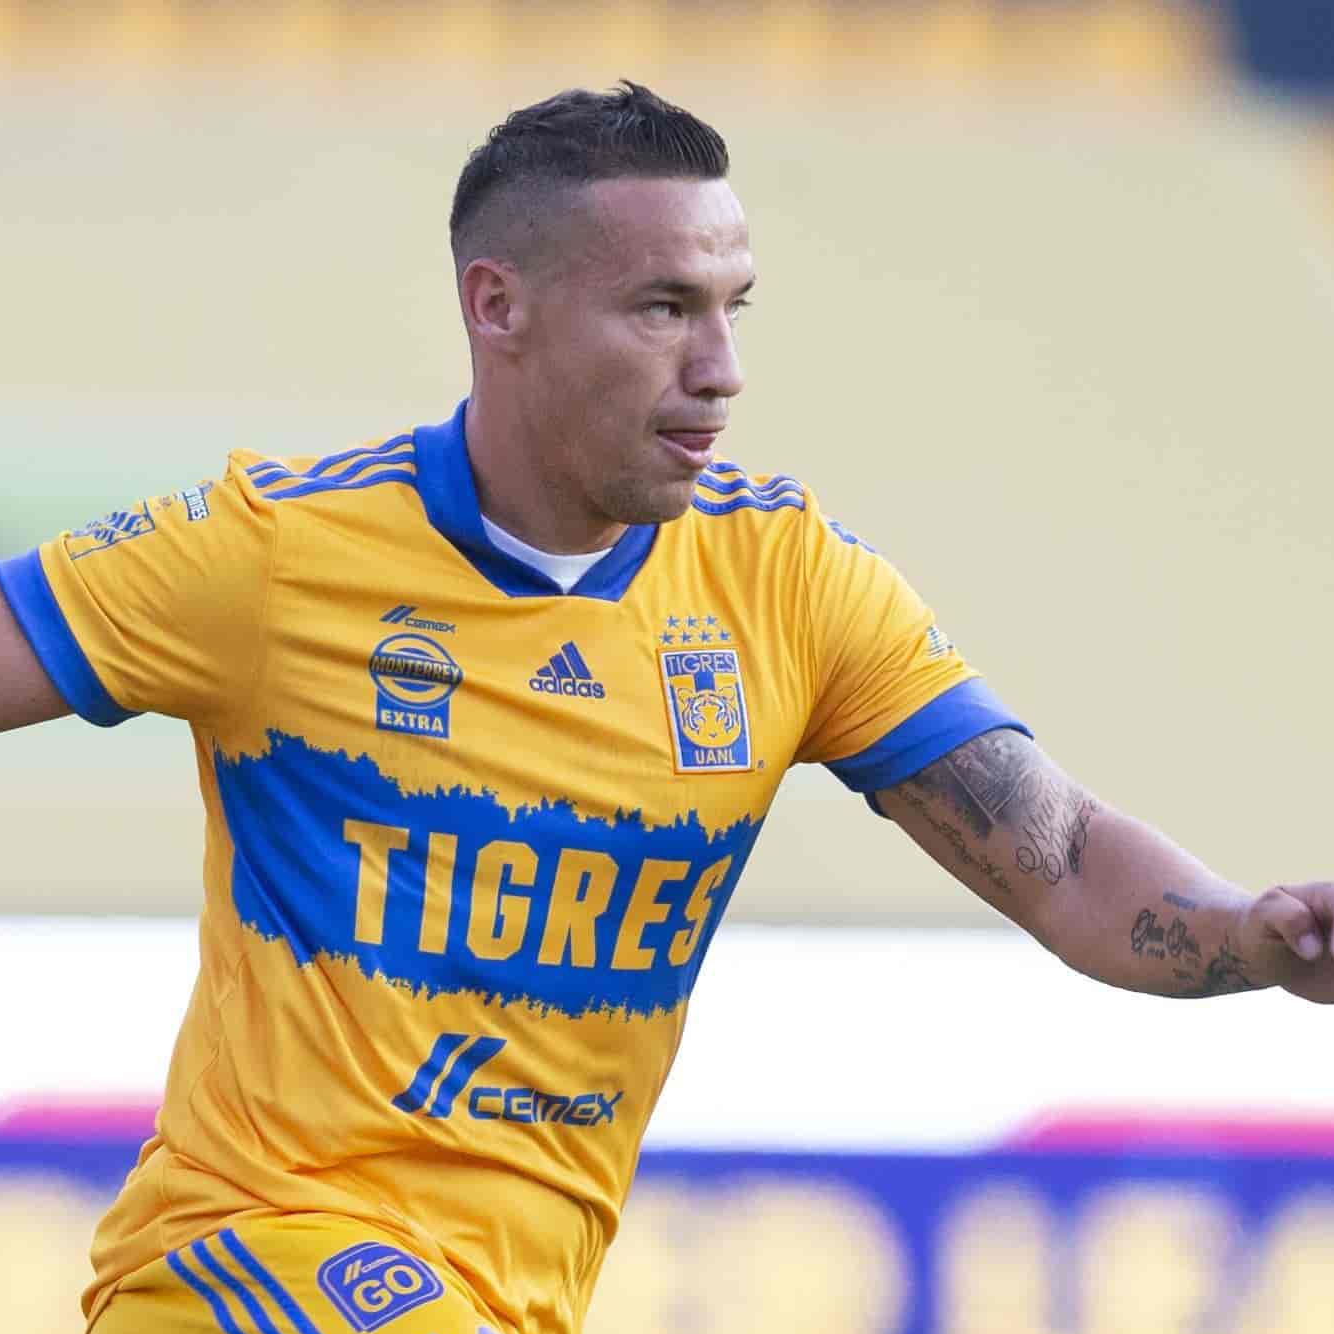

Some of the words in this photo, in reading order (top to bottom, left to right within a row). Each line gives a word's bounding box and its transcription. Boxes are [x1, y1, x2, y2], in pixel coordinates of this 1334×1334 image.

[666, 653, 736, 675] TIGRES
[529, 677, 606, 700] adidas
[380, 708, 445, 733] EXTRA
[694, 748, 736, 765] UANL
[343, 818, 734, 971] TIGRES
[468, 1086, 624, 1127] CEMEX
[353, 1265, 422, 1313] GO
